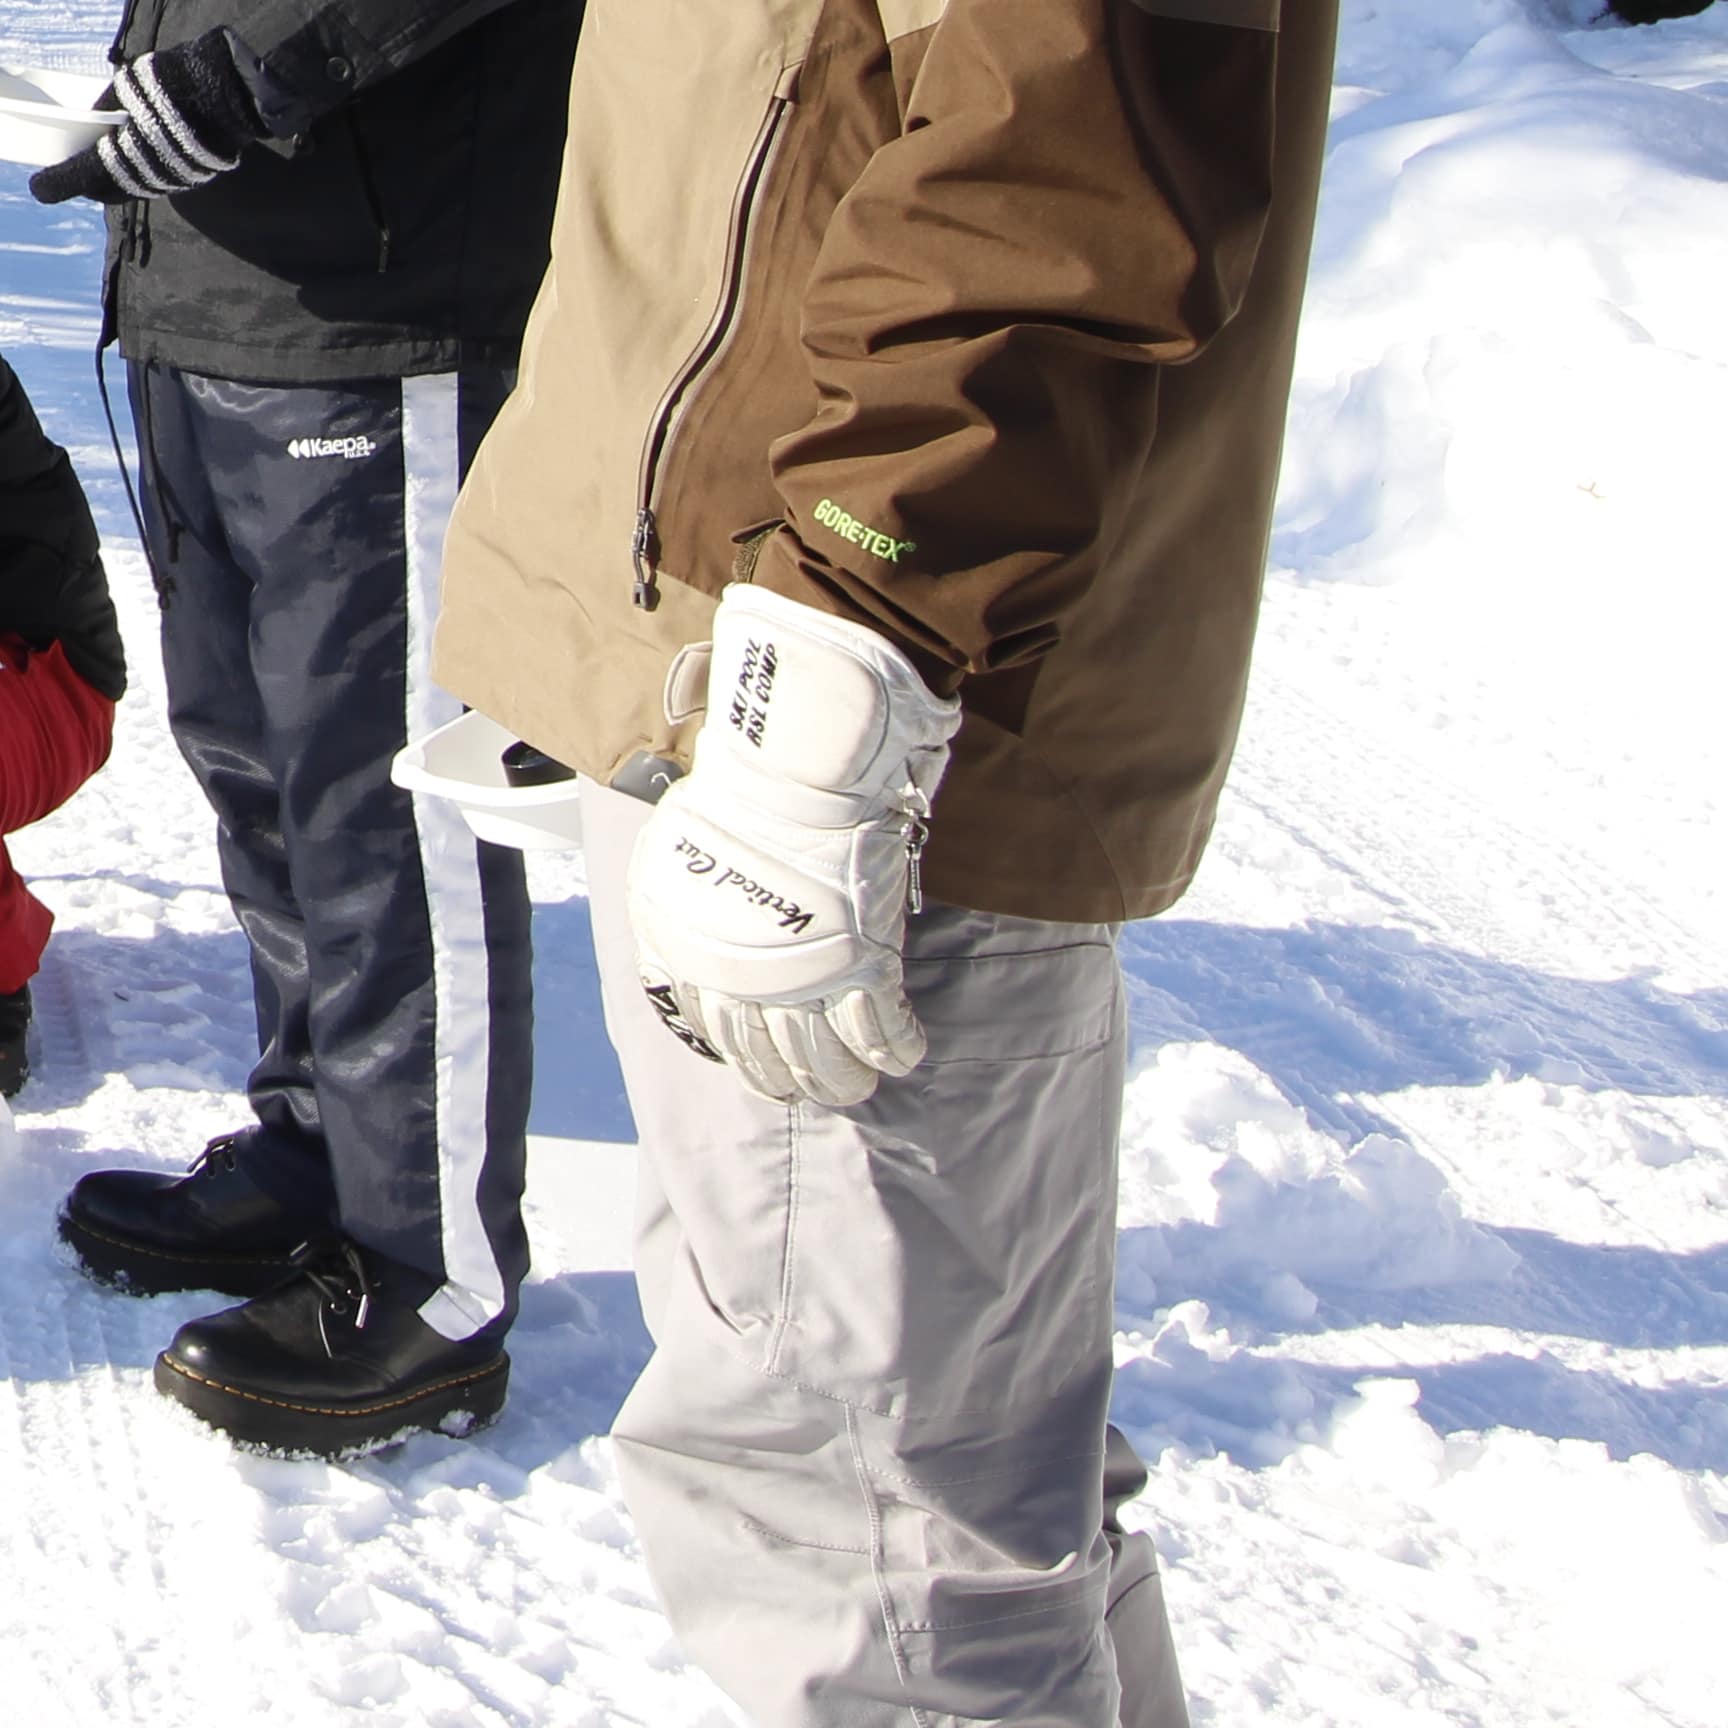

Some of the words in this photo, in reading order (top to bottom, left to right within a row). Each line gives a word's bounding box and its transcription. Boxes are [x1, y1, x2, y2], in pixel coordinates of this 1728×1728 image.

[310, 435, 369, 459] Kaepa
[738, 638, 762, 695] POOL
[755, 643, 778, 704] COMP
[729, 690, 748, 732] SKI
[674, 837, 716, 874] Cut
[713, 867, 815, 934] Vertical
